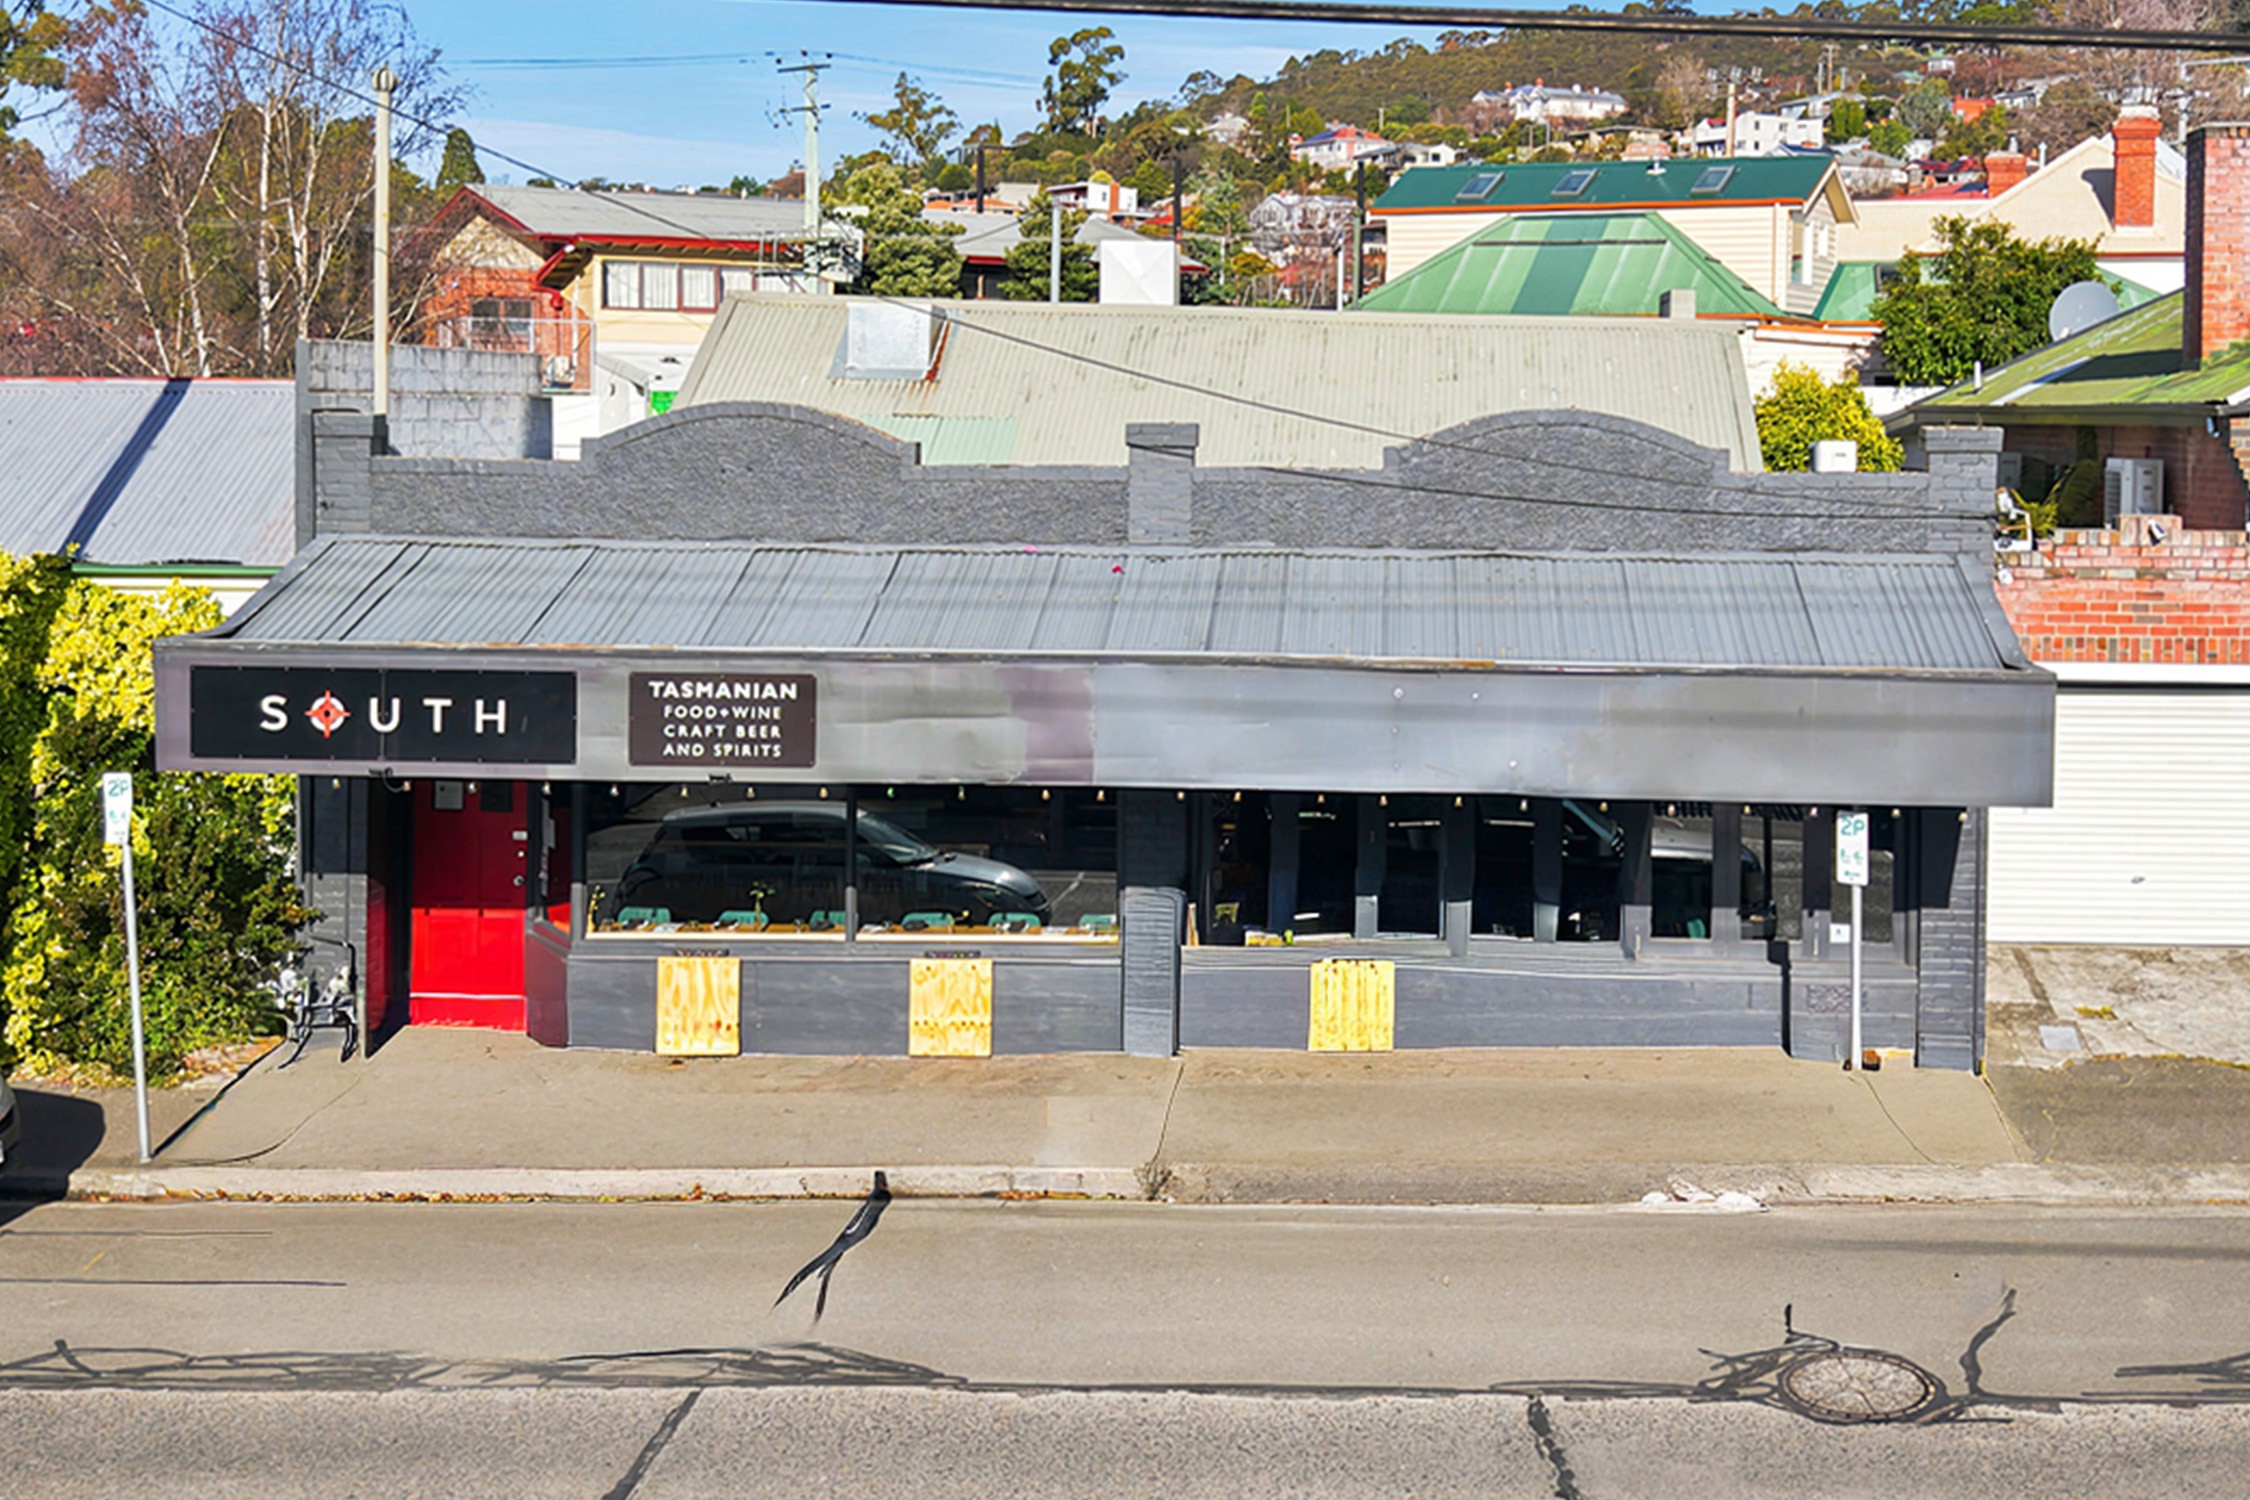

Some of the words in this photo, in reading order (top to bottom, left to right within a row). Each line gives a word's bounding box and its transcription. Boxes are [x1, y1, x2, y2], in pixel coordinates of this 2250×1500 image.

[649, 681, 797, 700] TASMANIAN
[259, 691, 507, 738] SOUTH
[663, 724, 726, 738] CRAFT
[735, 725, 781, 739] BEER
[663, 743, 705, 757] AND
[713, 744, 782, 758] SPIRITS
[108, 779, 129, 797] 2P
[1840, 818, 1866, 836] 2P
